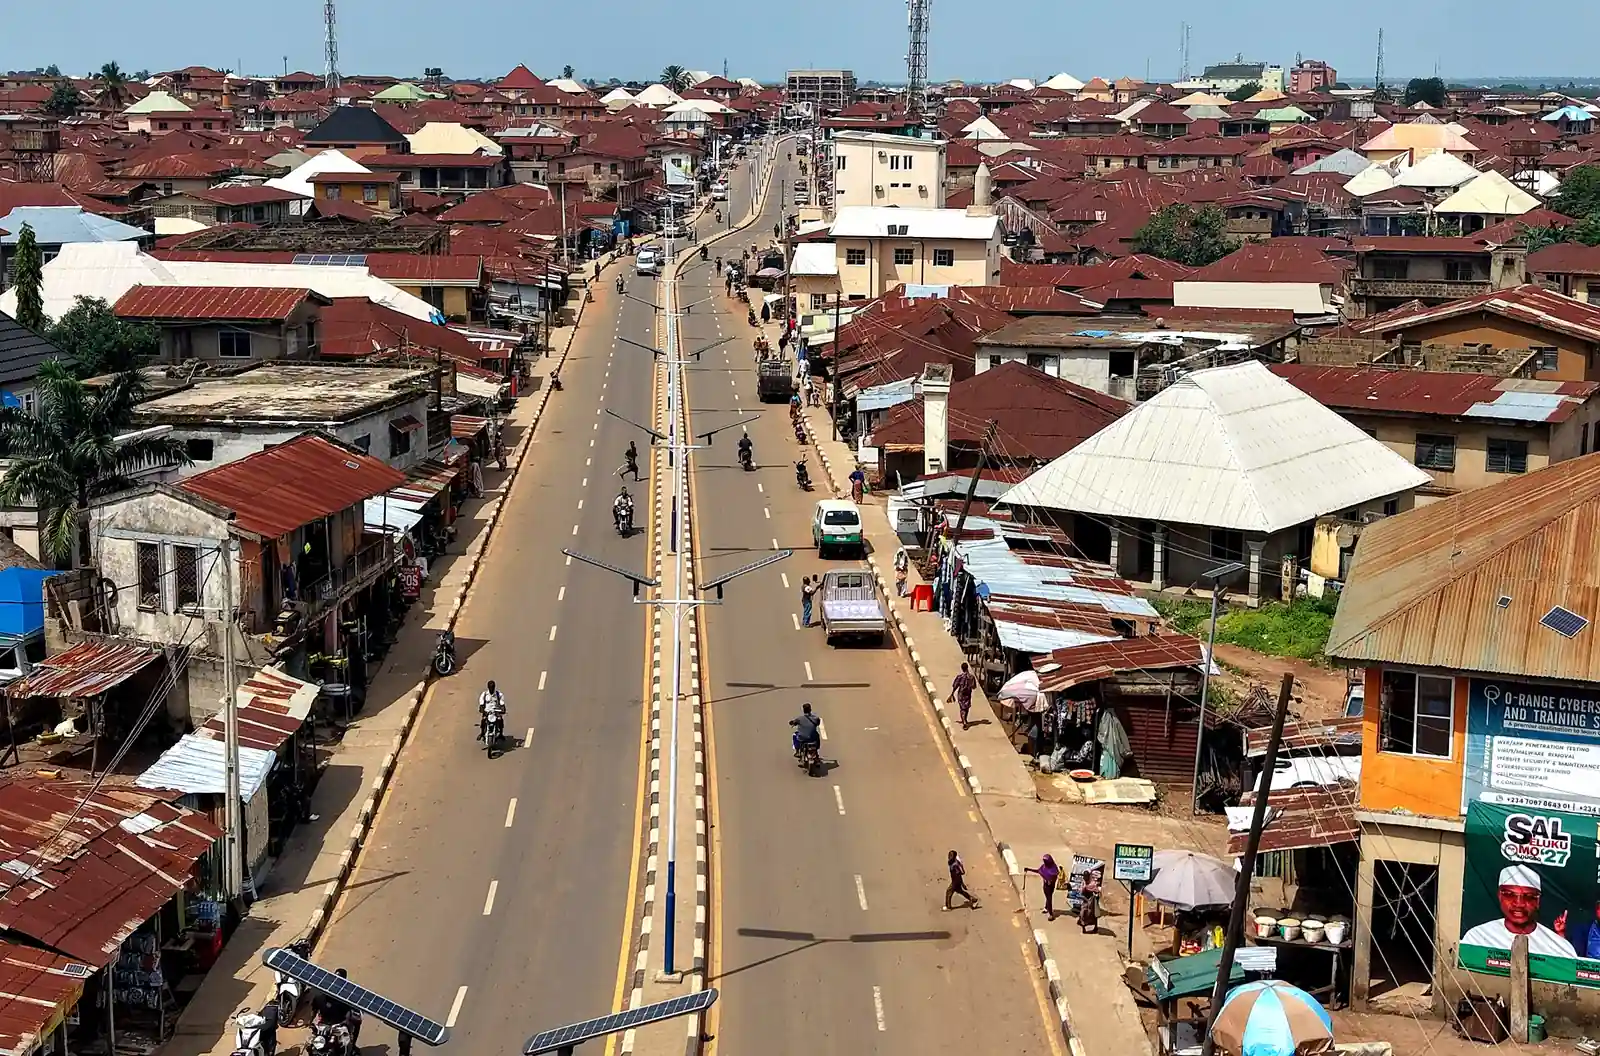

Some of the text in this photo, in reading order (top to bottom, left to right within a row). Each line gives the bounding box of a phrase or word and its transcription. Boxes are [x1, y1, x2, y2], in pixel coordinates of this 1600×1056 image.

[1503, 706, 1527, 721] AND
[1533, 709, 1586, 727] TRAINING
[1538, 724, 1573, 733] destination
[1525, 742, 1564, 750] PENETRATION
[1496, 755, 1521, 763] WEBSITE
[1558, 761, 1600, 770] MAINTENANCE
[1496, 763, 1571, 775] CYBERSECURITY TRAINING
[1508, 816, 1568, 844] SAL
